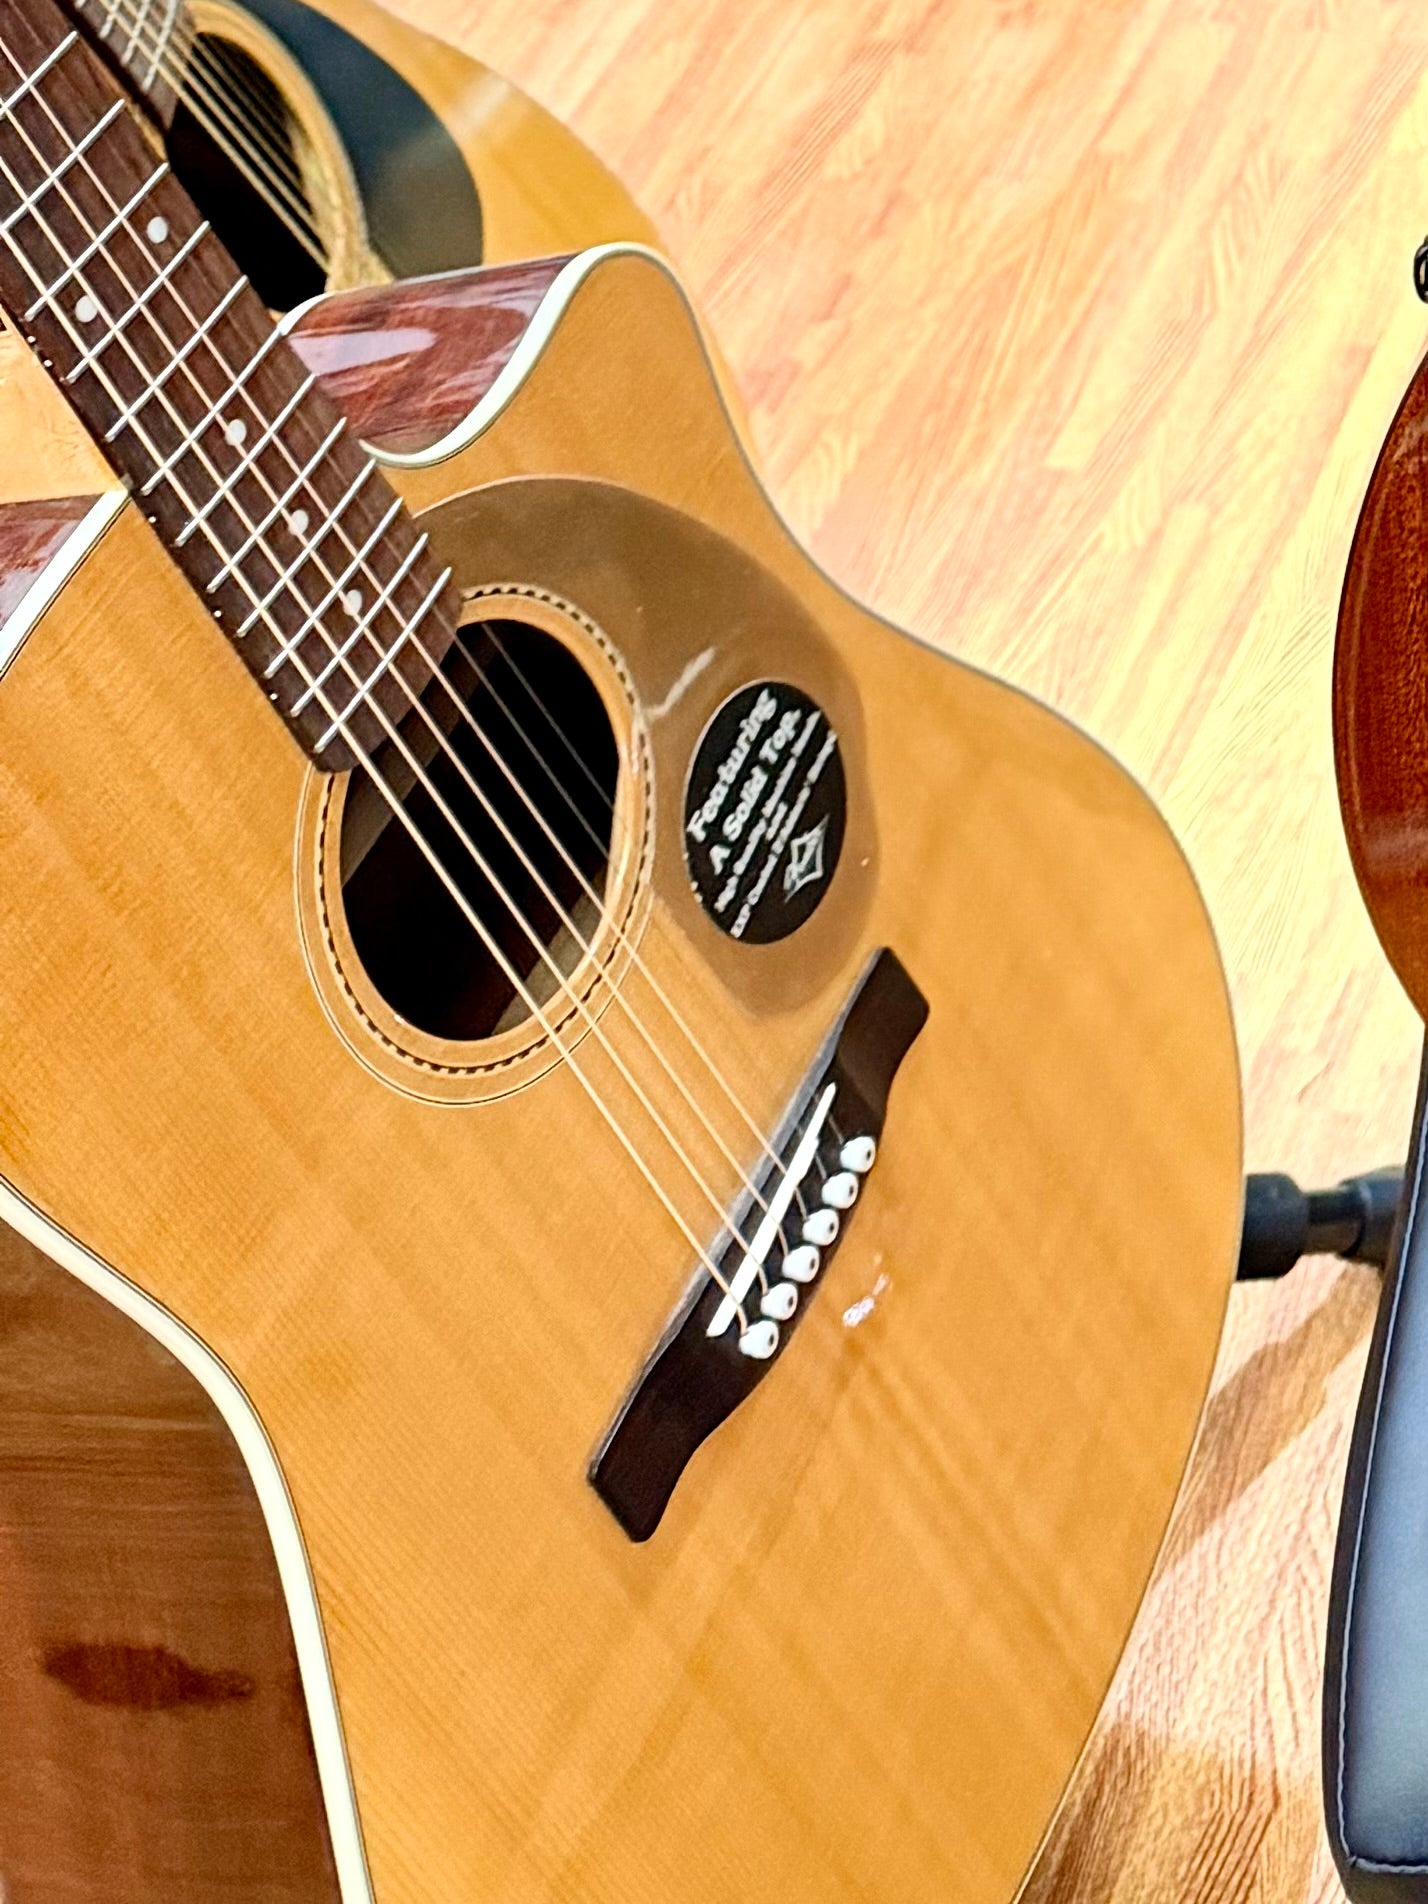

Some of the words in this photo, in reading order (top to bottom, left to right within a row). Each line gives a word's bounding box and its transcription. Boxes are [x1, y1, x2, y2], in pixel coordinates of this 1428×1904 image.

[686, 688, 778, 843] Featuring
[709, 843, 732, 876] A
[722, 764, 769, 842] Solid
